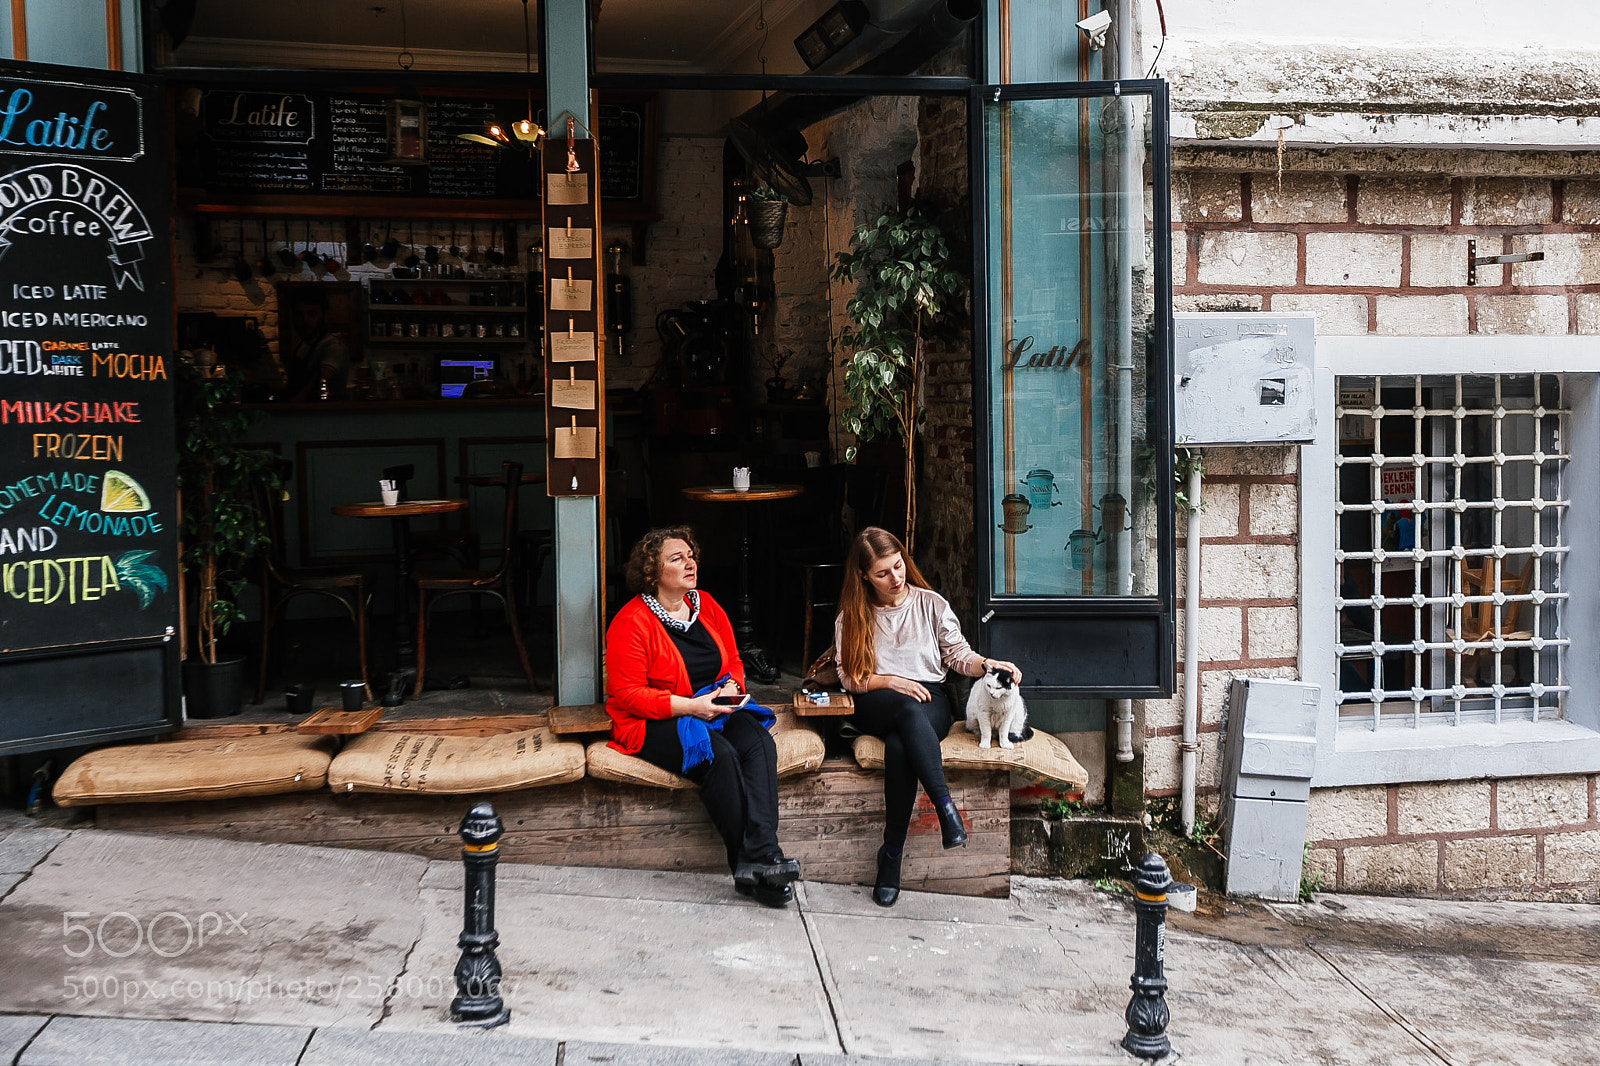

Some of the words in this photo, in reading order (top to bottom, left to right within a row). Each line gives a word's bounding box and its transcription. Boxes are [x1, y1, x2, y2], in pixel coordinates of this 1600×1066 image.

[0, 88, 113, 150] Latife
[219, 94, 300, 127] Latife
[0, 174, 52, 214] OLD
[62, 170, 149, 239] BREW
[13, 284, 55, 300] ICED
[63, 284, 107, 300] LATTE
[1, 310, 48, 328] ICED
[52, 312, 148, 327] AMERICANO
[0, 340, 42, 376] CED
[42, 364, 84, 376] WHITE
[91, 352, 167, 381] MOCHA
[51, 354, 82, 365] DARK
[1, 400, 142, 425] MILKSHAKE
[33, 433, 123, 461] FROZEN
[1381, 471, 1415, 484] EKLENE
[0, 472, 100, 513] OMEMADE
[38, 494, 164, 537] LEMONADE
[0, 526, 58, 555] AND
